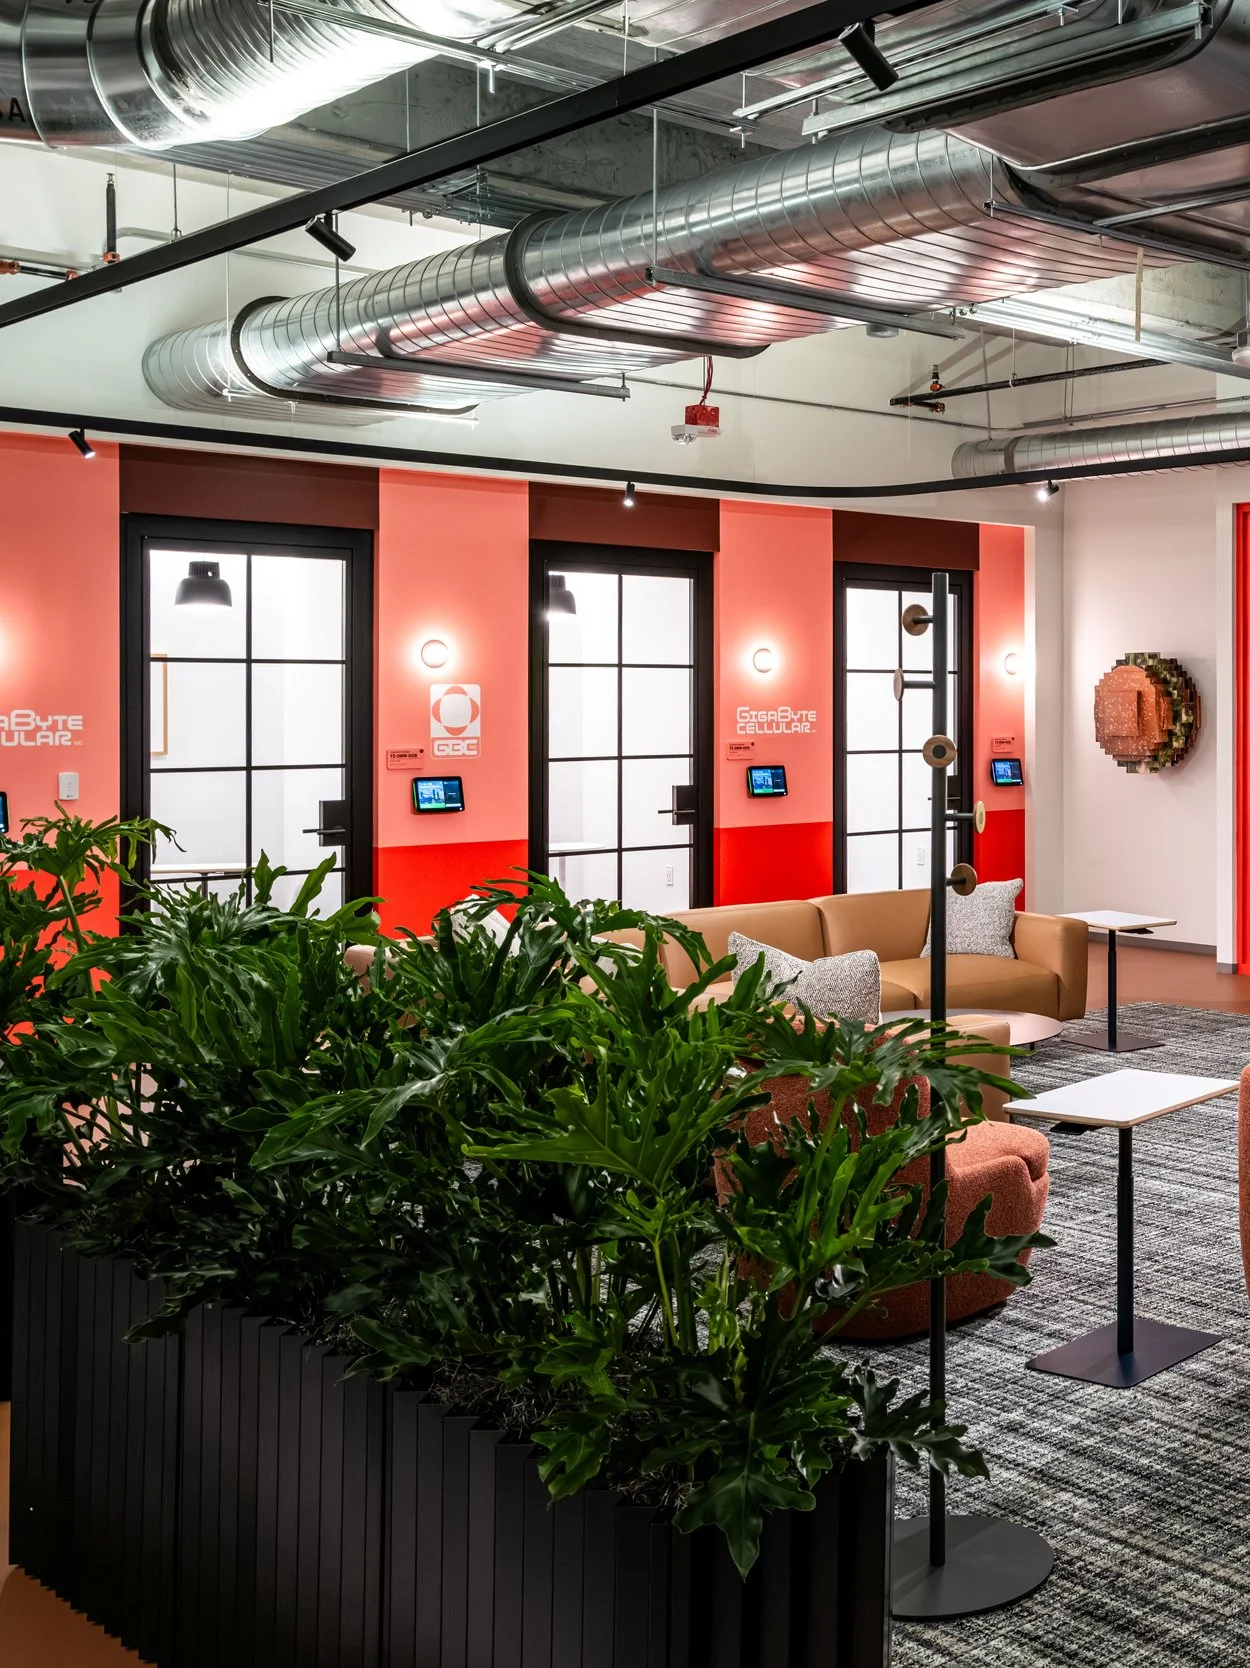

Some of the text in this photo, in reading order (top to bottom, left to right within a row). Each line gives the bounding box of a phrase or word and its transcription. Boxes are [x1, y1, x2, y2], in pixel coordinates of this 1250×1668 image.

[0, 97, 26, 123] A
[736, 722, 811, 735] CELLULAR
[433, 739, 478, 756] GBC
